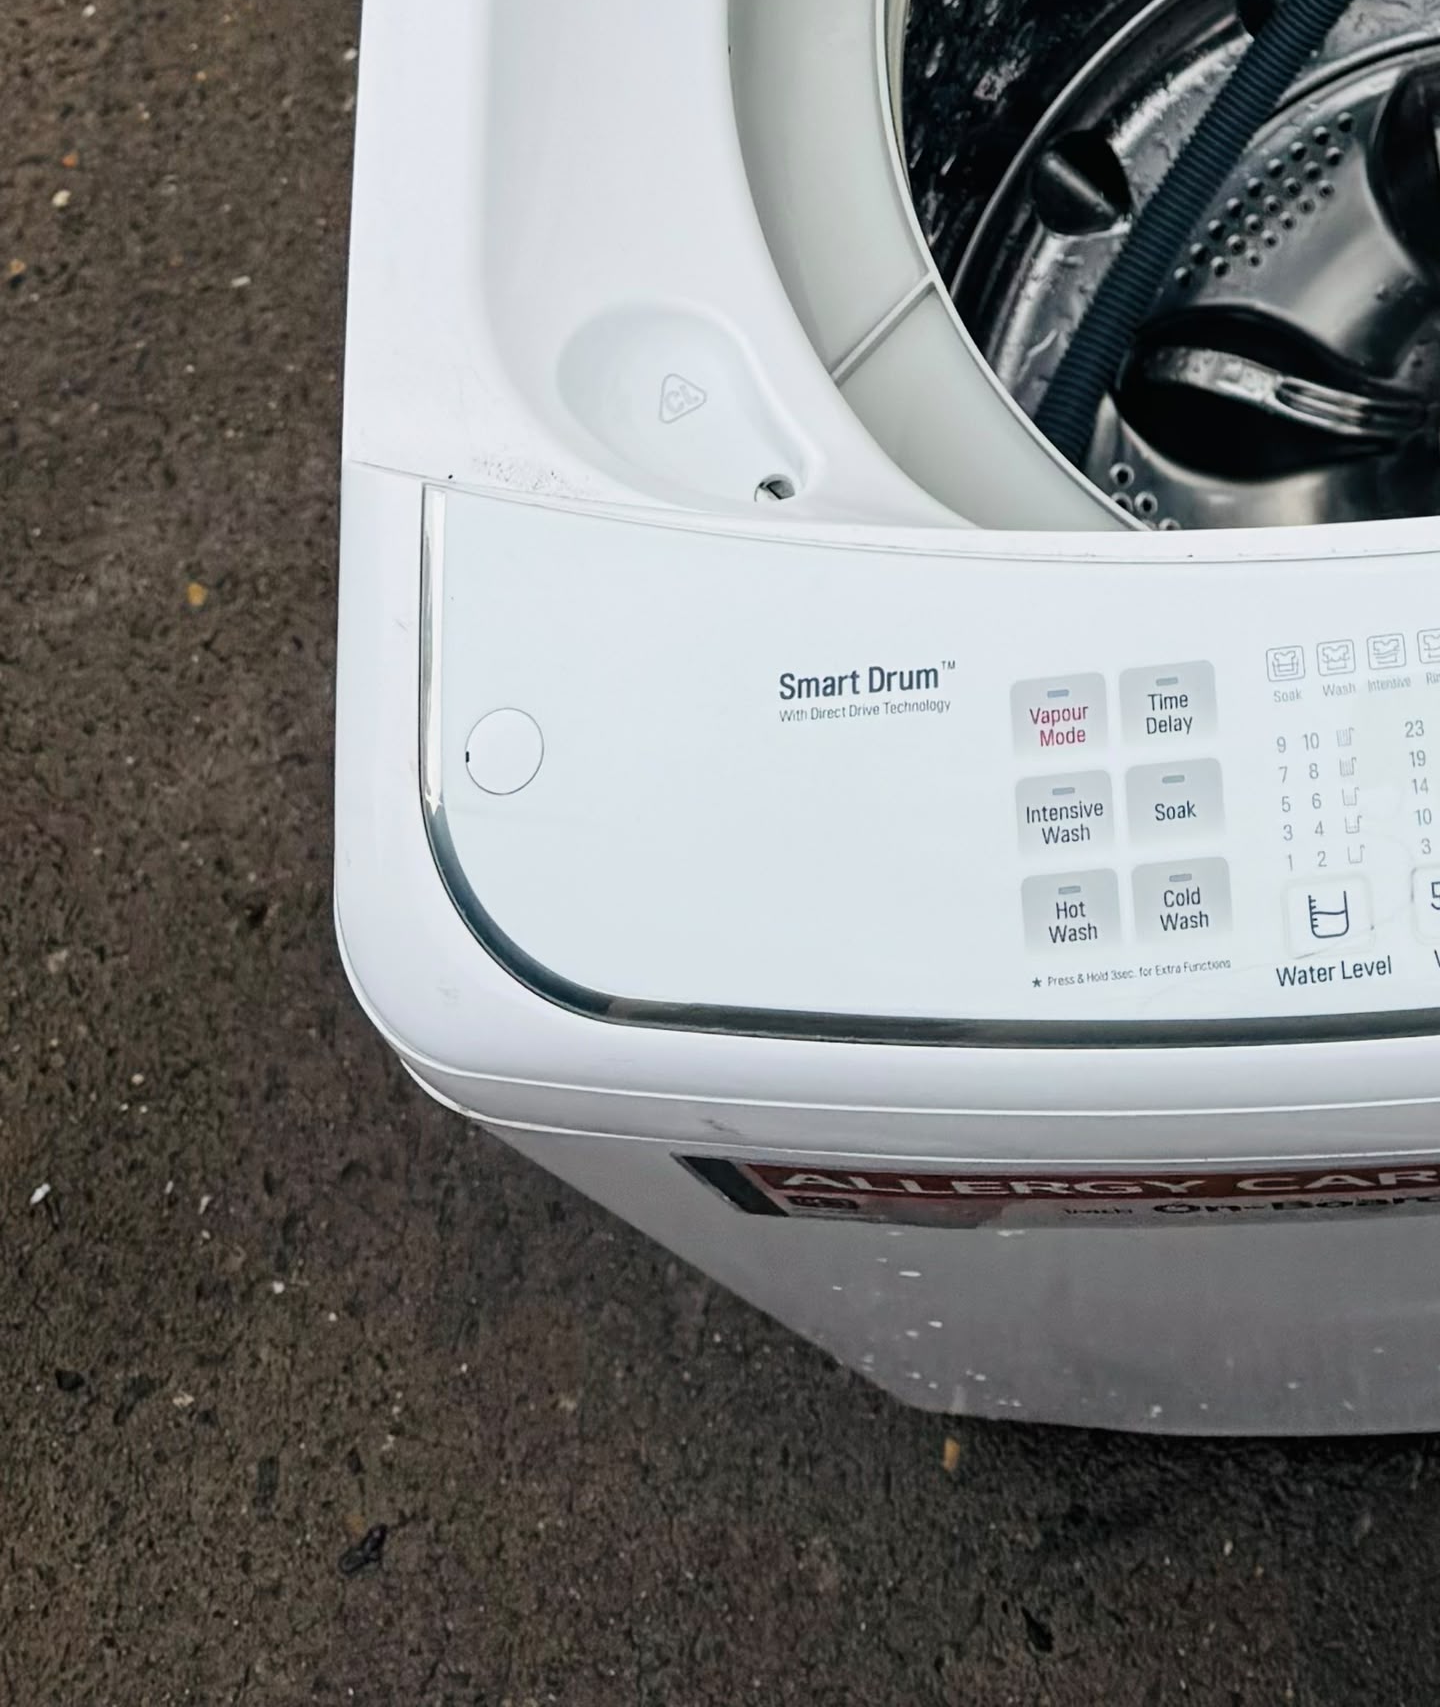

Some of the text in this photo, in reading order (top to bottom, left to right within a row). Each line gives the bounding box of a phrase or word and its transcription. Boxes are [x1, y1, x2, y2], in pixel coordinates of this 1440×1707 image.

[779, 670, 860, 700] Smart
[1322, 682, 1356, 697] Wash
[1367, 676, 1412, 692] Intensive
[1147, 693, 1188, 711] Time
[1273, 687, 1302, 703] Soak
[779, 699, 951, 722] With Direct Drive Technology
[1030, 705, 1089, 726] Vapour
[1146, 716, 1193, 735] Delay
[1405, 720, 1424, 738] 23
[1039, 729, 1086, 747] Mode
[1277, 732, 1320, 753] 9 10
[1409, 750, 1426, 768] 19
[1279, 763, 1319, 783] 7 8
[1412, 777, 1429, 795] 14
[1026, 801, 1104, 823] Intensive
[1154, 801, 1197, 821] Soak
[1282, 793, 1322, 812] 5 6
[1415, 808, 1432, 826] 10
[1042, 824, 1091, 844] Wash
[1283, 820, 1324, 841] 3 4
[1421, 838, 1432, 855] 3
[1287, 850, 1327, 871] 1 2
[1163, 886, 1201, 907] Cold
[1056, 901, 1086, 919] Hot
[1160, 911, 1209, 931] Wash
[1048, 924, 1098, 944] Wash
[1048, 975, 1075, 987] Press
[1077, 974, 1085, 984] &
[1087, 971, 1108, 983] Hold
[1139, 967, 1152, 976] for
[1155, 964, 1181, 975] Extra
[1183, 959, 1231, 973] Functions
[1276, 956, 1392, 987] Water Level
[777, 1172, 1206, 1196] ALLERGY
